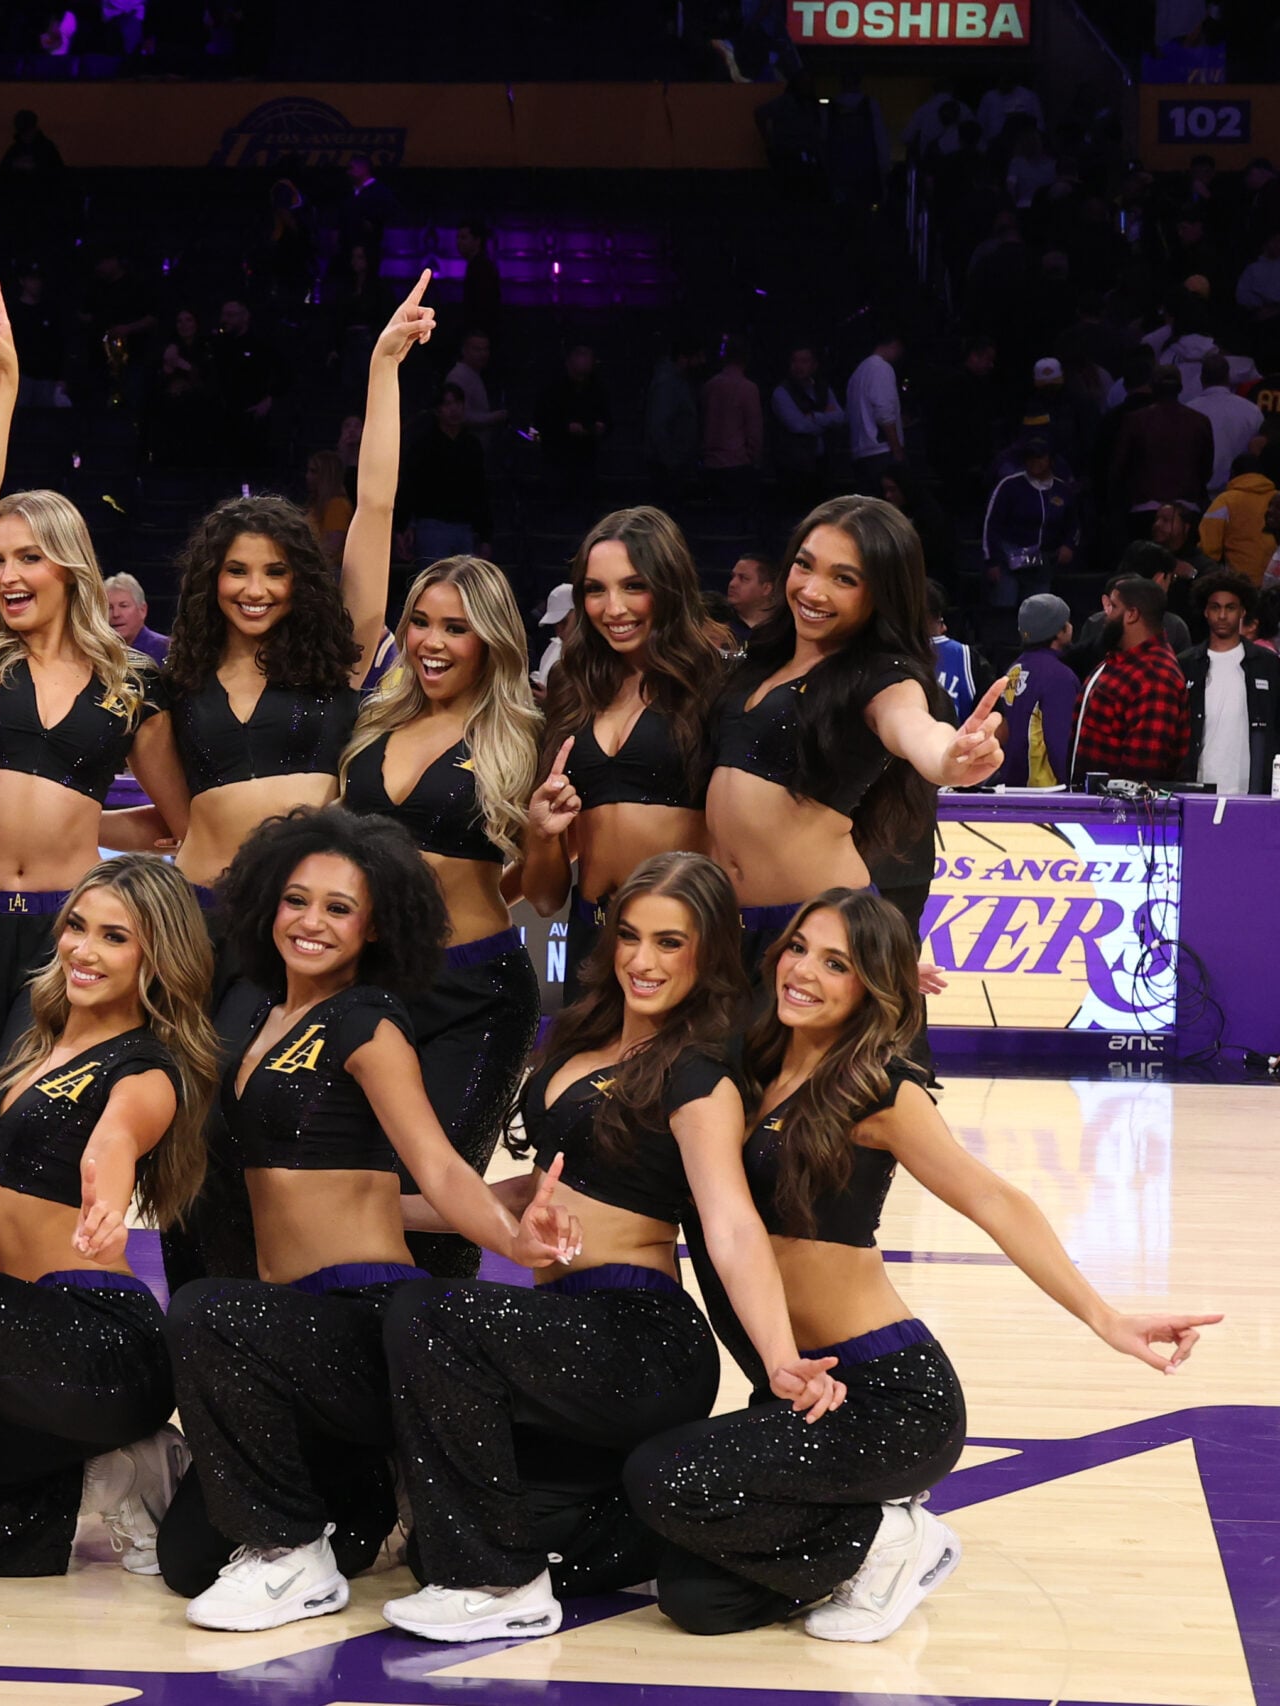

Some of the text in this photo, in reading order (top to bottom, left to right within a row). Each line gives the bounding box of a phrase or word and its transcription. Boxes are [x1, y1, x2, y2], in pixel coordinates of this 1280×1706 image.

[792, 1, 1024, 39] TOSHIBA
[1169, 106, 1242, 137] 102
[932, 856, 976, 880] OS
[8, 893, 28, 912] LAL
[264, 1024, 326, 1074] LA
[34, 1061, 102, 1104] LA
